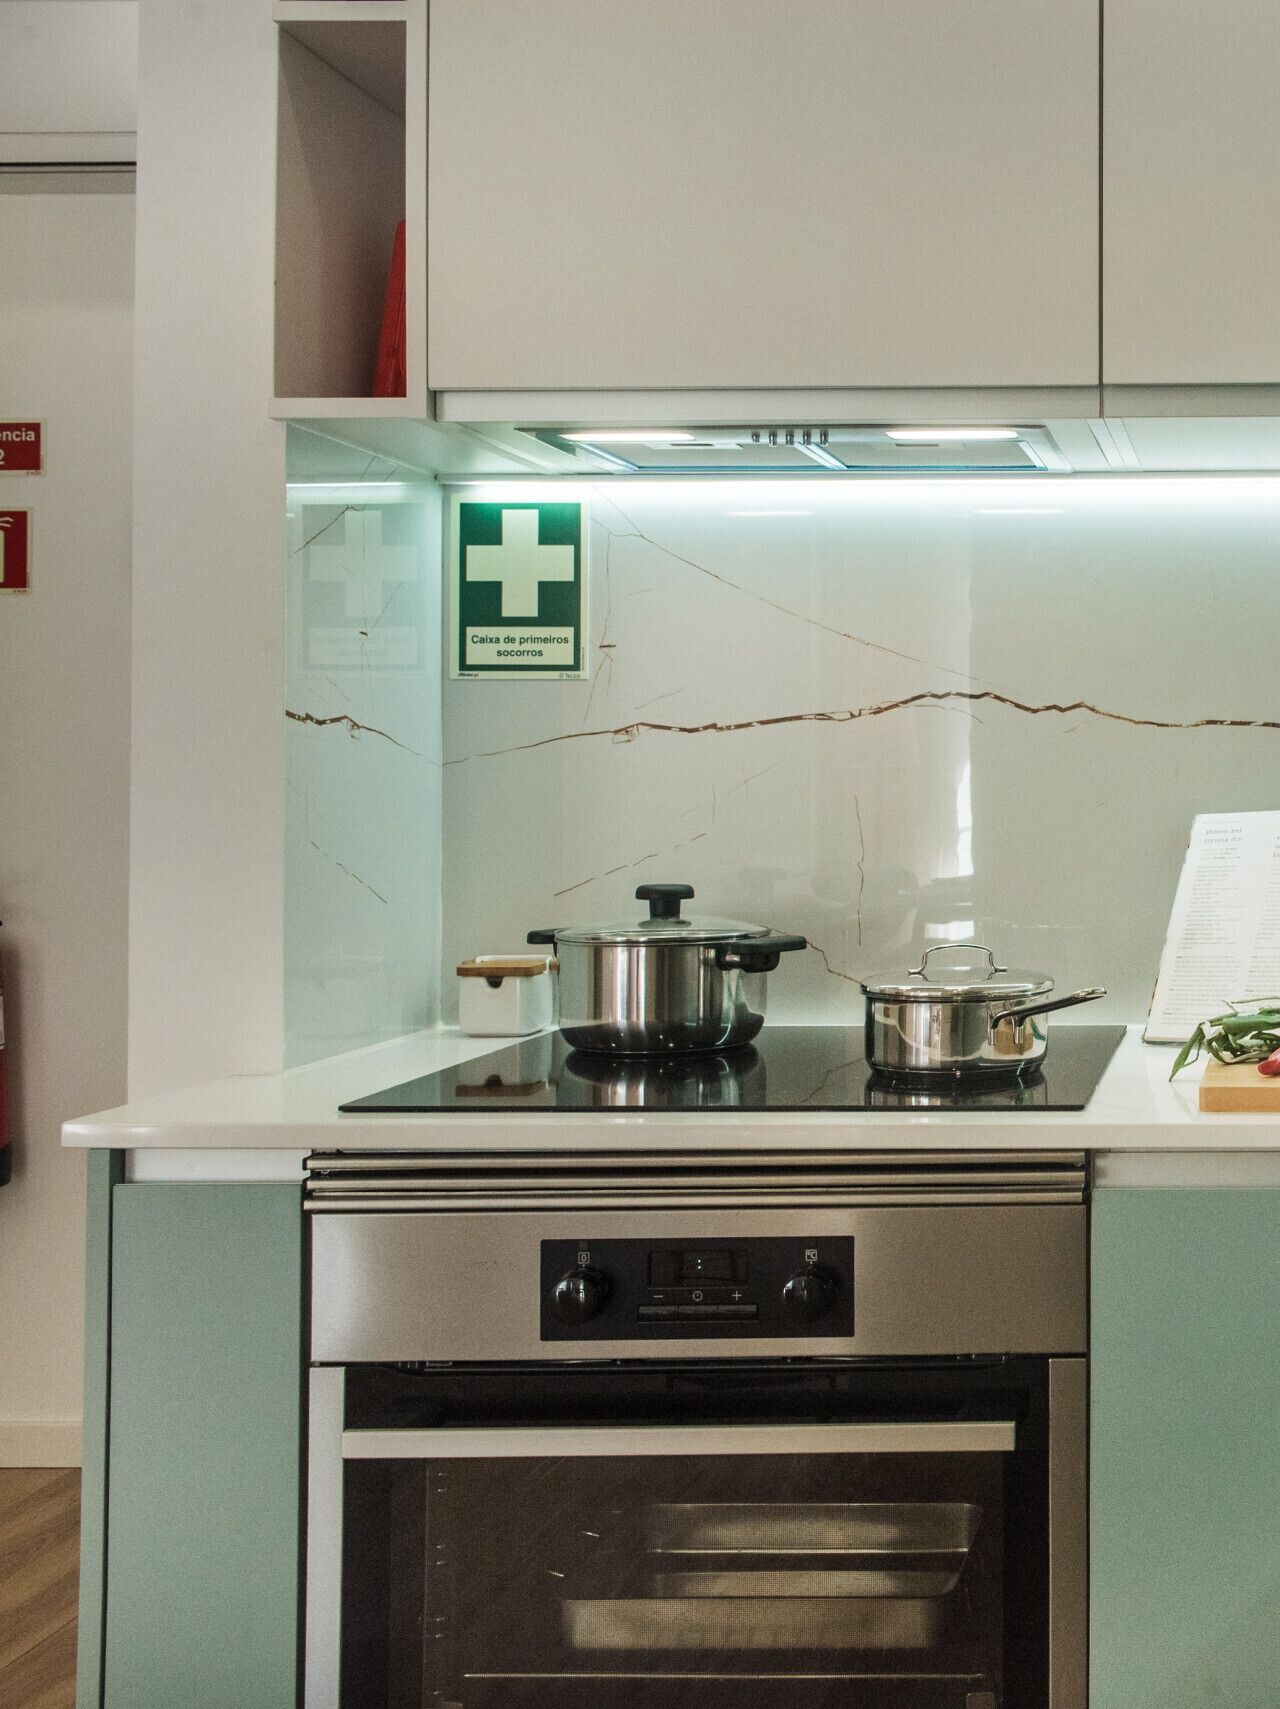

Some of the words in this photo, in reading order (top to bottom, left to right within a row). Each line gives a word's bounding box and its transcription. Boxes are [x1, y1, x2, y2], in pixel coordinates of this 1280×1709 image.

[0, 428, 35, 441] ncia
[471, 635, 501, 644] Caixa
[503, 635, 516, 644] de
[519, 635, 569, 646] primeiros
[496, 649, 544, 657] socorros
